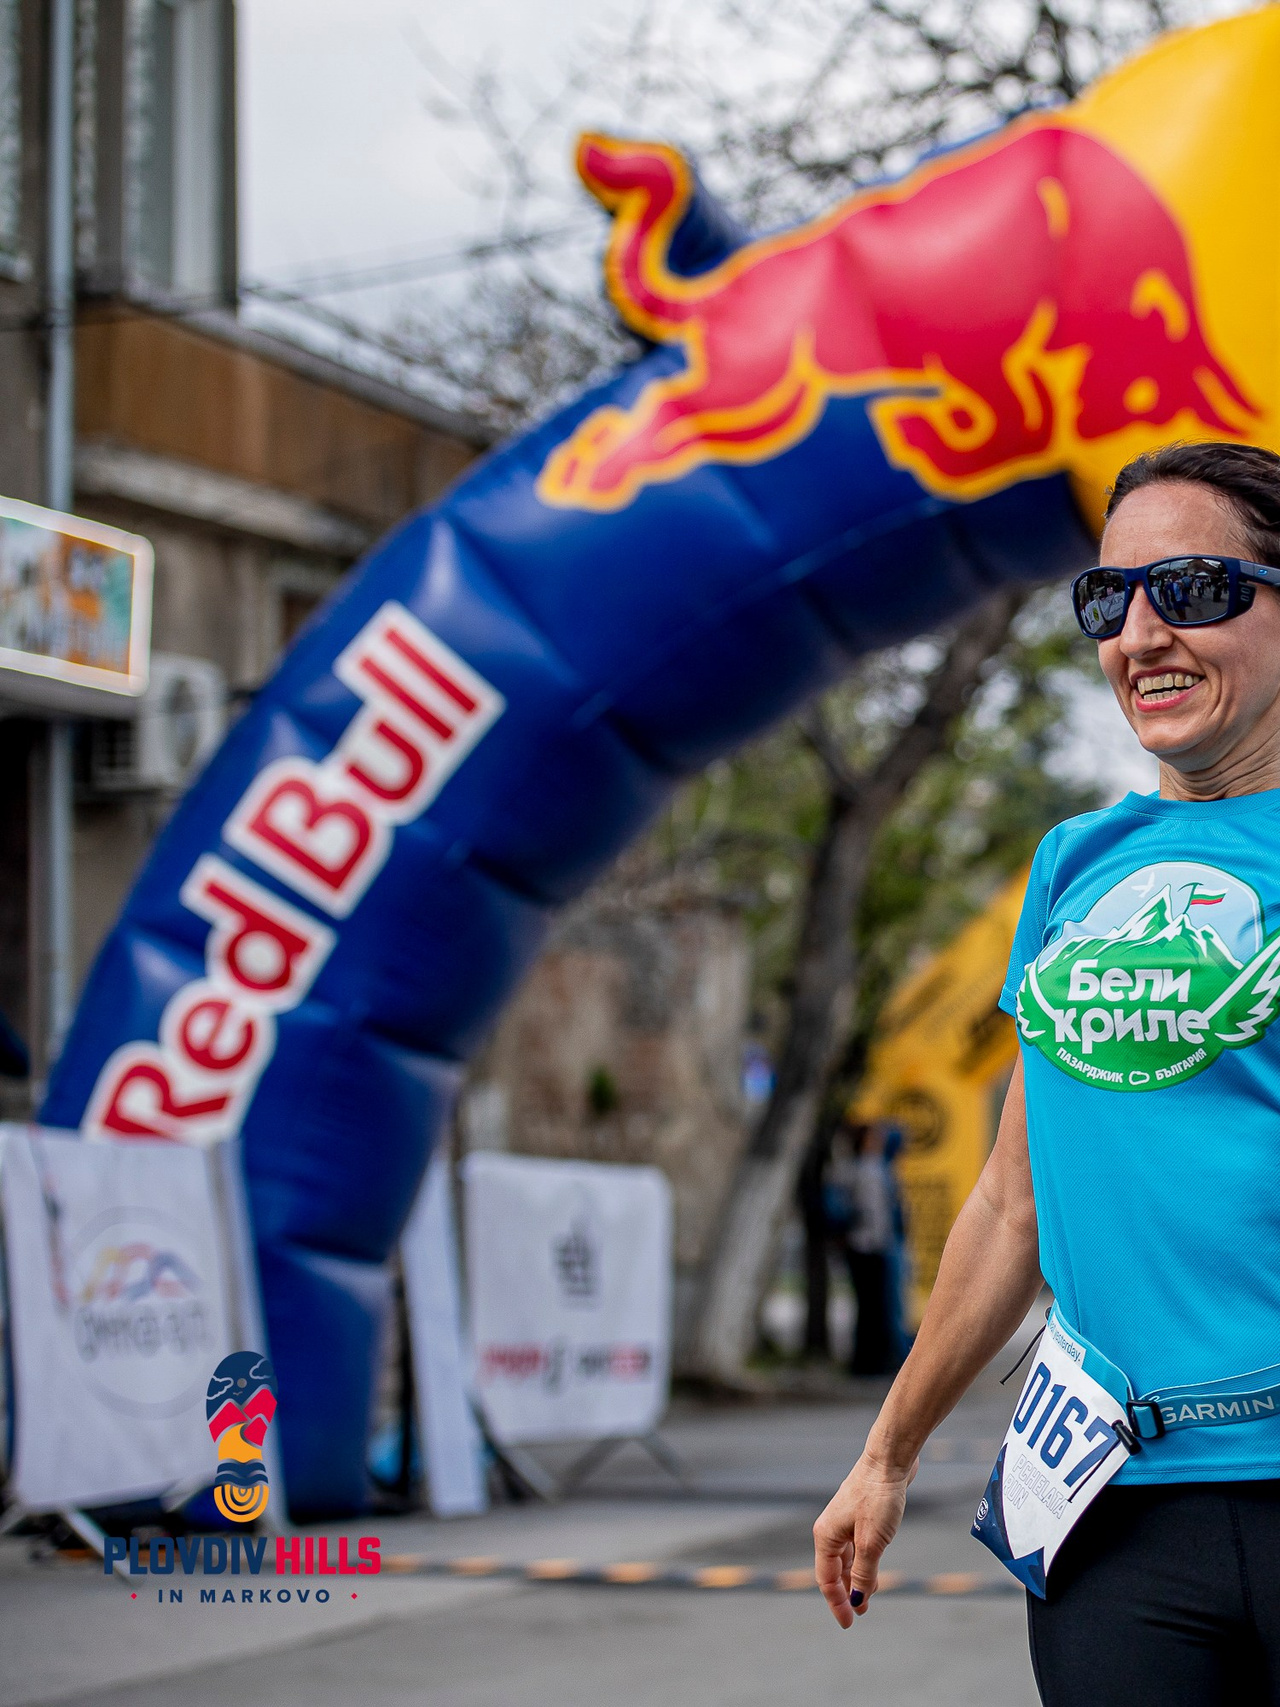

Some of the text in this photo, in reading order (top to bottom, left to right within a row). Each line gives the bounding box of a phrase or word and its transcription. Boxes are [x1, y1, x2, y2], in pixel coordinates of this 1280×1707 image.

[98, 872, 318, 1142] Red
[242, 620, 484, 897] Bull
[1066, 958, 1191, 1003] Бели
[1053, 1007, 1210, 1054] криле
[1056, 1047, 1207, 1083] ПАЗАРДЖИК БЪЛГАРИЯ
[1013, 1361, 1122, 1488] 0167
[1160, 1395, 1275, 1425] GARMIN
[1003, 1473, 1029, 1510] RUN
[1012, 1453, 1069, 1519] PCHELATA
